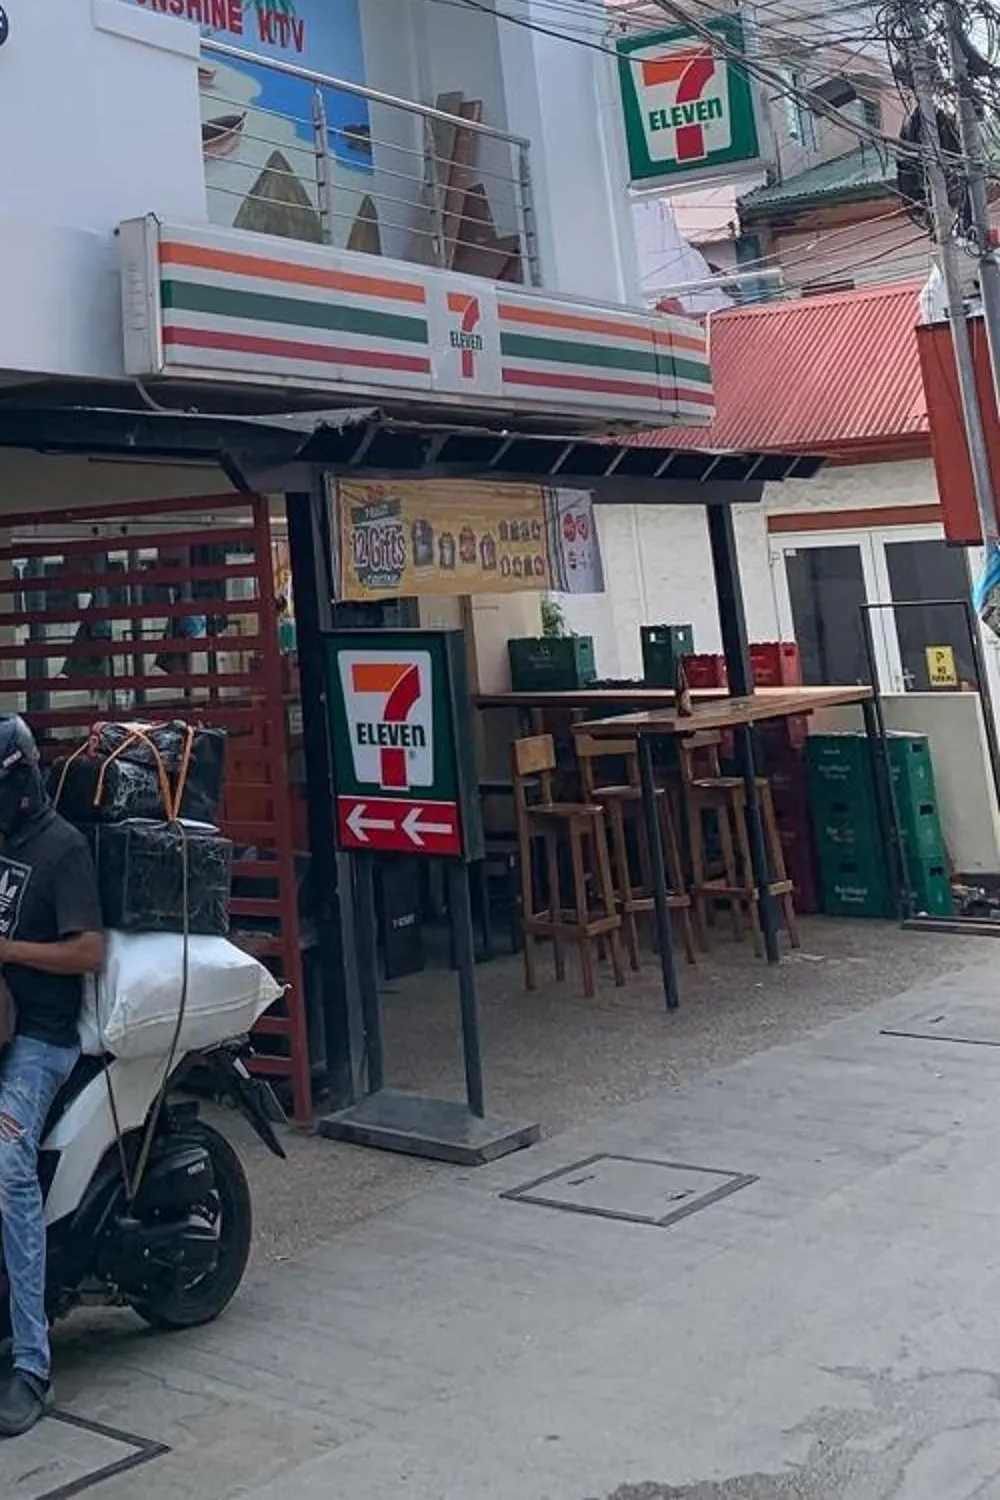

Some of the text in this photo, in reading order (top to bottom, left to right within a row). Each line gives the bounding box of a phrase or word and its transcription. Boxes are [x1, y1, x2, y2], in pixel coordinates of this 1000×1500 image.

[256, 7, 305, 53] KTV
[641, 46, 716, 161] 7
[445, 291, 480, 379] 7
[351, 663, 421, 787] 7
